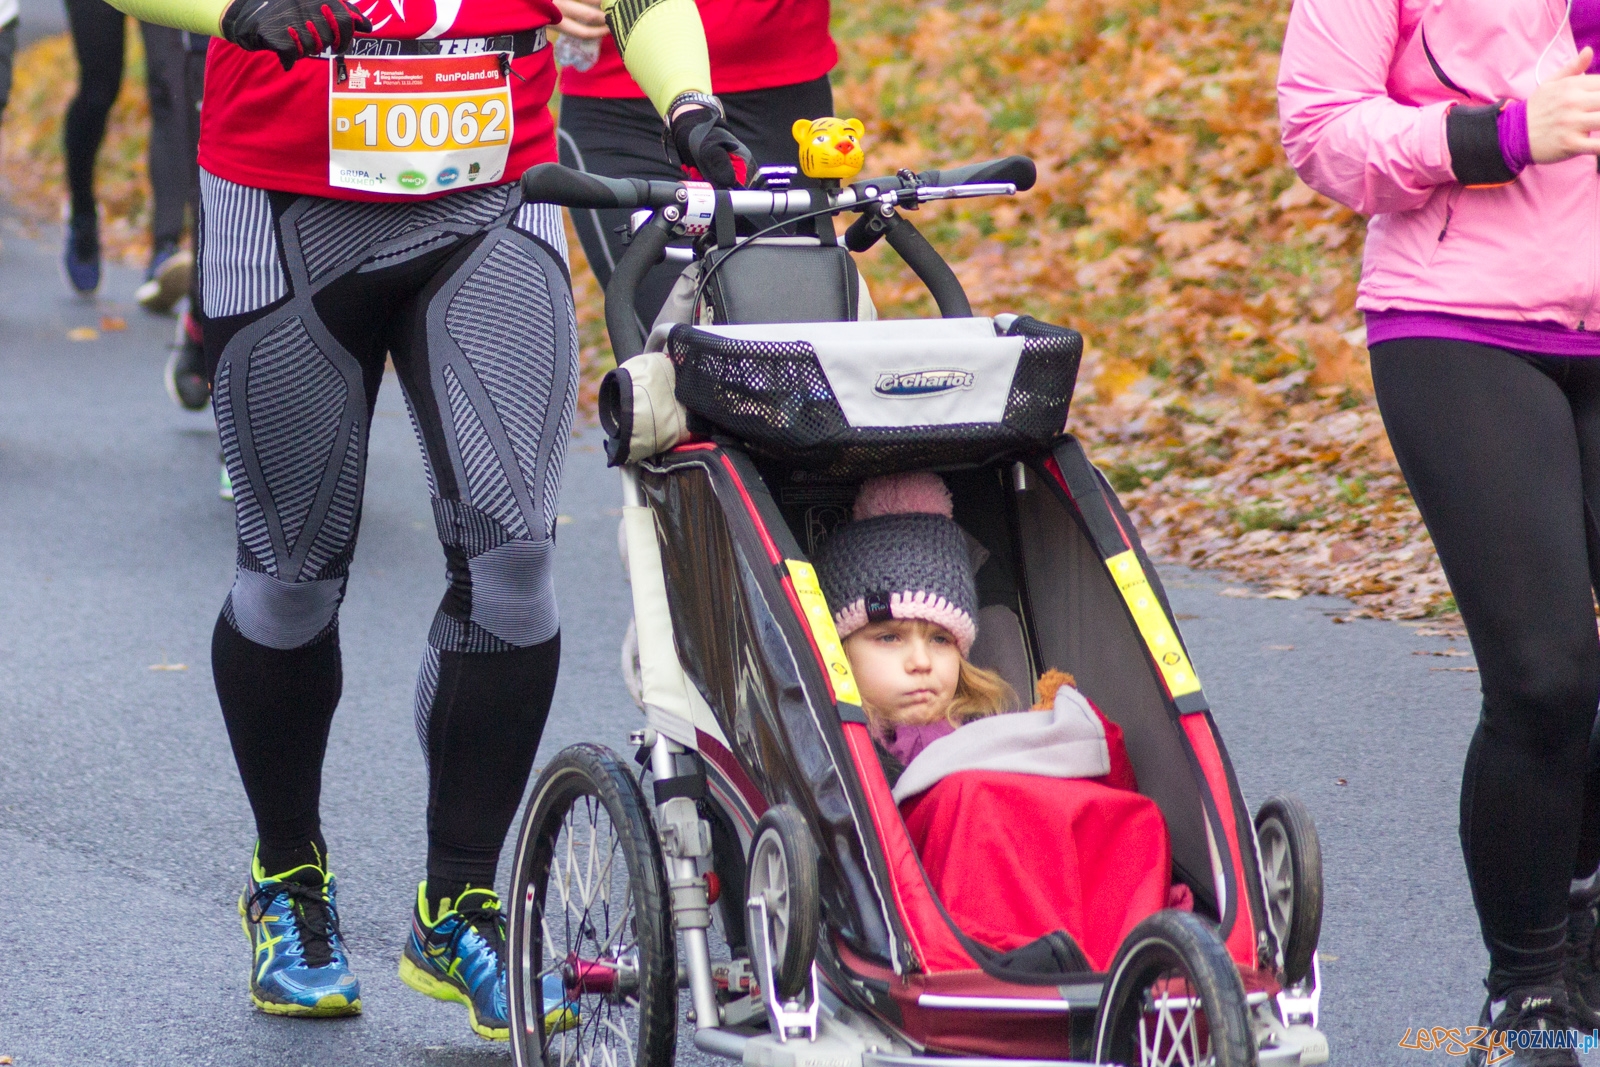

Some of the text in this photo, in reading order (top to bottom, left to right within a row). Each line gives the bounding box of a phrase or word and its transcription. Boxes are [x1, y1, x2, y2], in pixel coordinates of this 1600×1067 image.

[435, 69, 499, 82] RunPoland.org
[336, 99, 506, 147] D 10062
[340, 169, 370, 178] GRUPA
[340, 176, 375, 186] LUXMED
